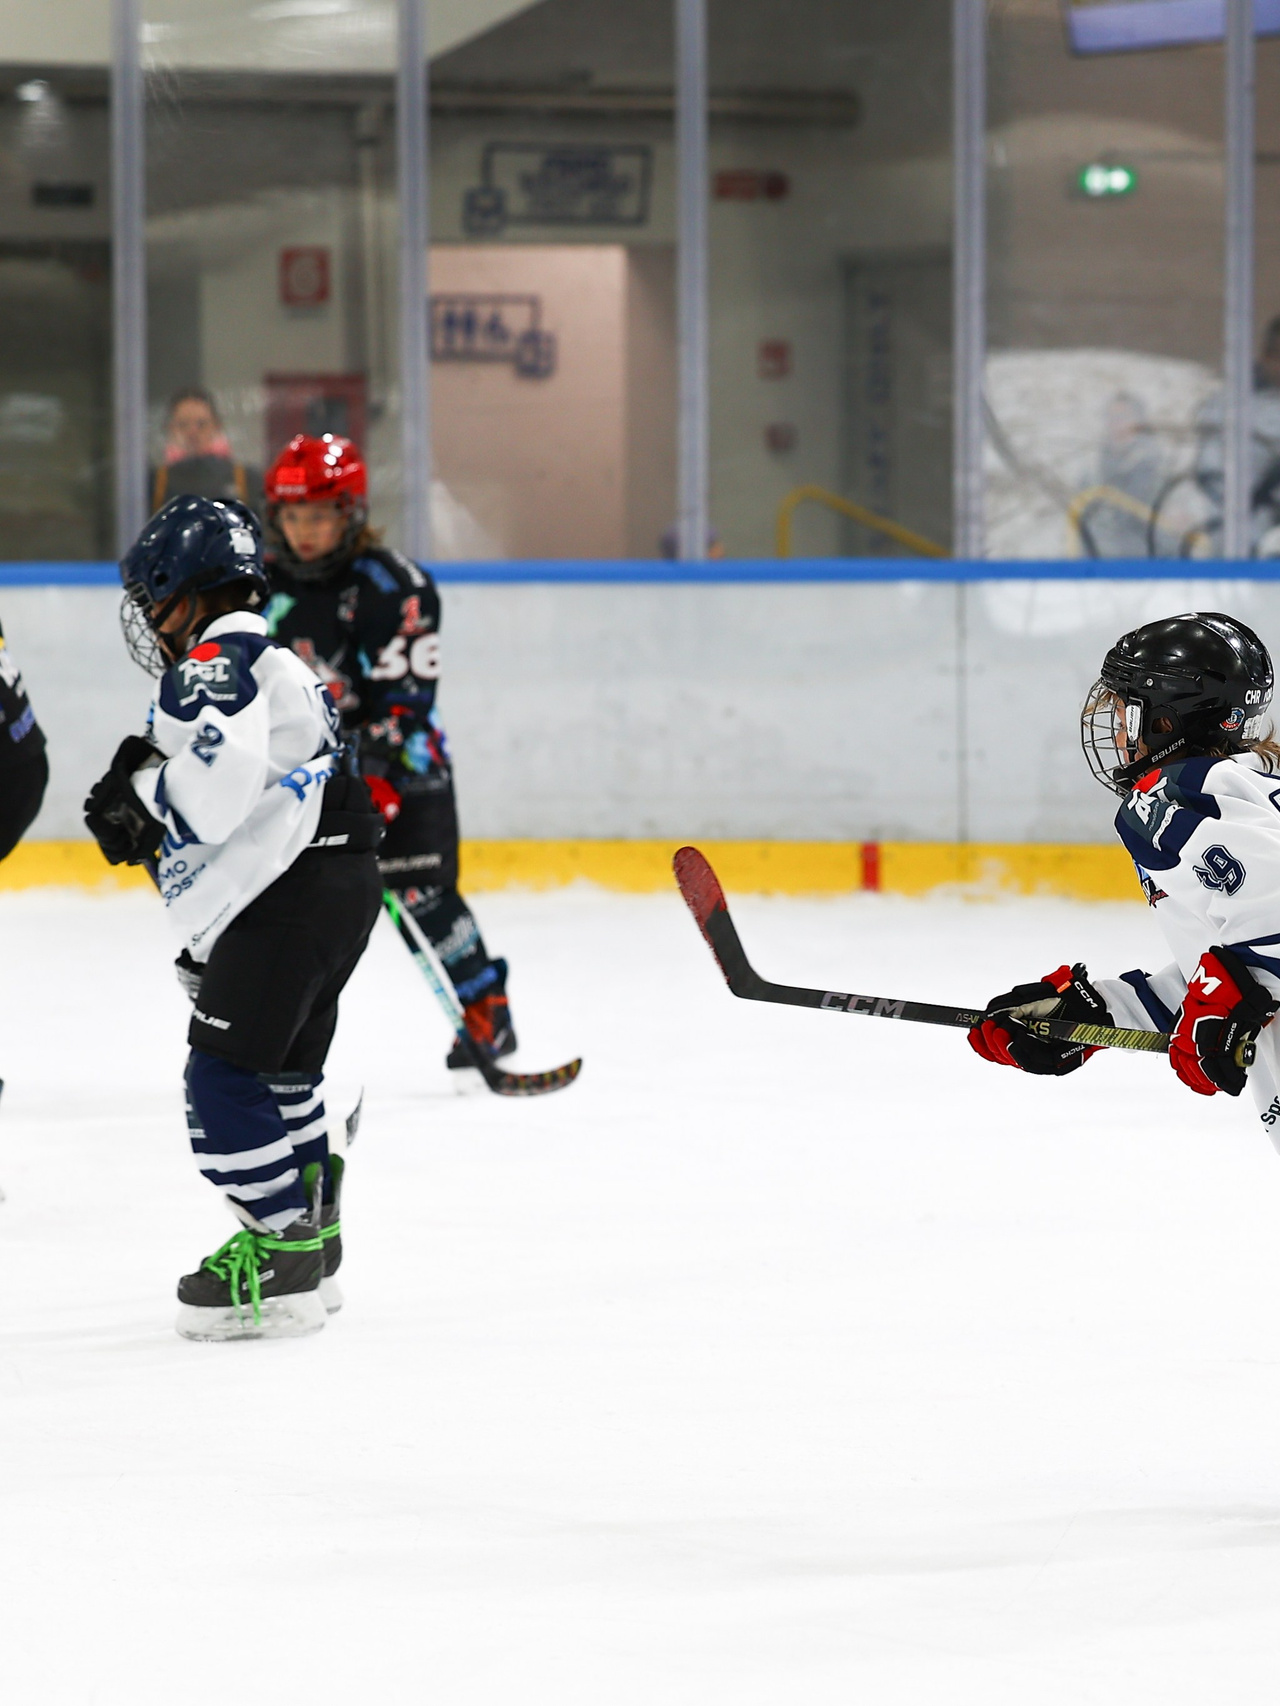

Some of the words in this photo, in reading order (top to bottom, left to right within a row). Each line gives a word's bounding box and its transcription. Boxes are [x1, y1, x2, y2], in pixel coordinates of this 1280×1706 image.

[1151, 737, 1186, 763] BAUER
[820, 990, 907, 1020] CCM
[1074, 980, 1099, 1009] CCM
[1060, 1044, 1086, 1059] TACKS
[1224, 1022, 1238, 1053] TACKS
